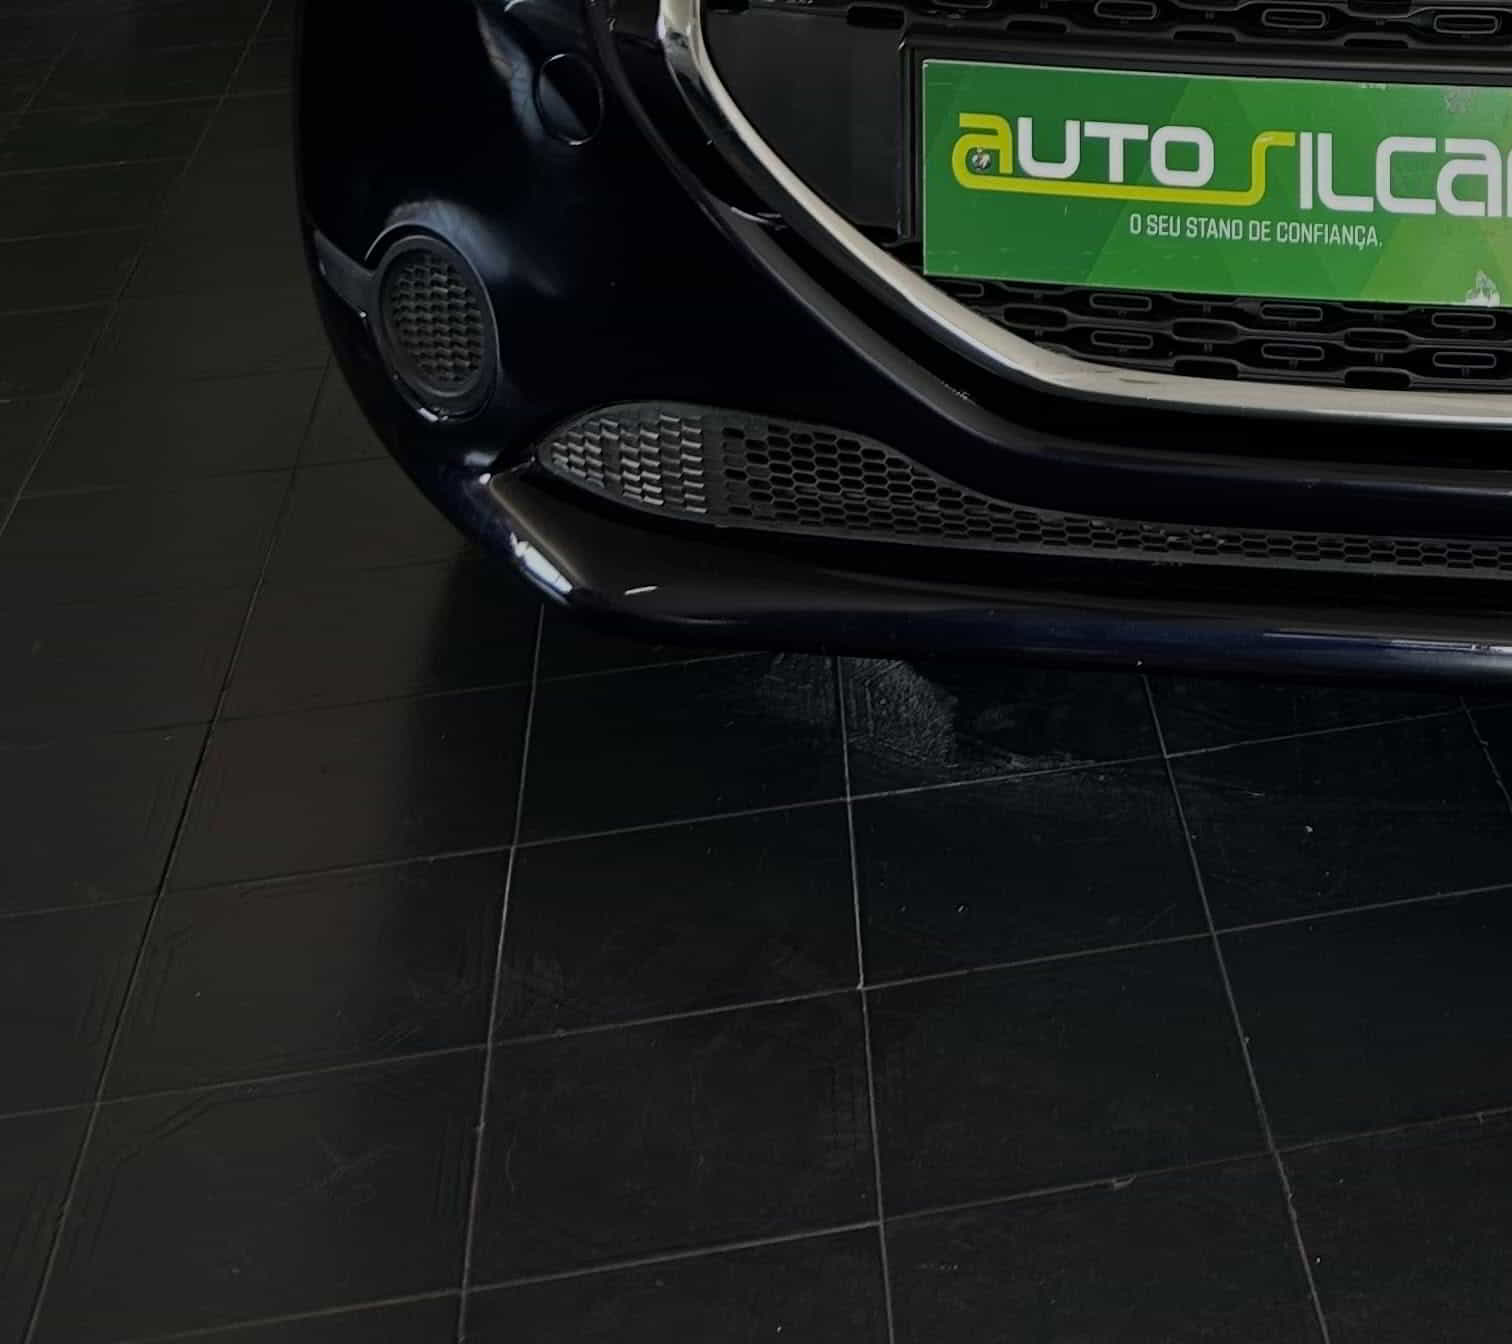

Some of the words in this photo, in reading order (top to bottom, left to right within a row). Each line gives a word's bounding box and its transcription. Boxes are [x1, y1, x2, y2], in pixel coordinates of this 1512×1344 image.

[1129, 213, 1142, 235] O
[1146, 214, 1181, 237] SEU
[1186, 216, 1243, 241] STAND
[1248, 220, 1272, 242] DE
